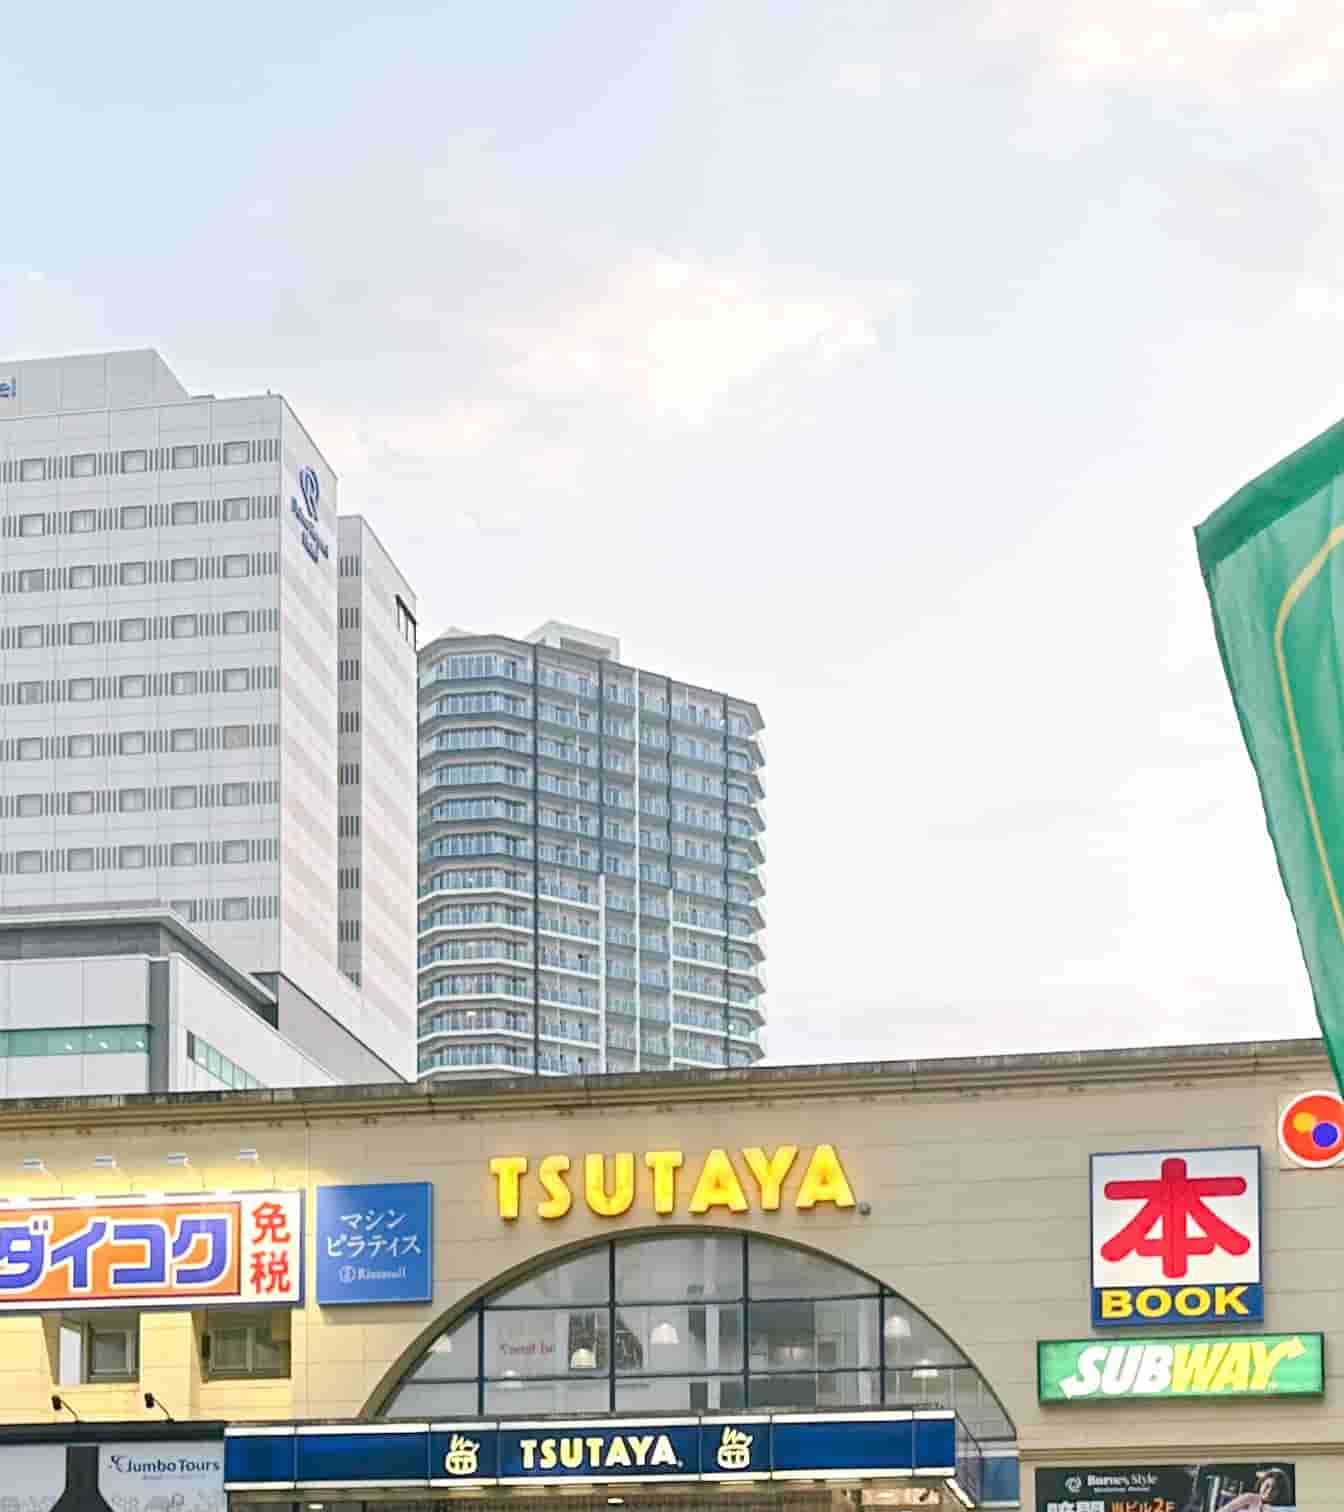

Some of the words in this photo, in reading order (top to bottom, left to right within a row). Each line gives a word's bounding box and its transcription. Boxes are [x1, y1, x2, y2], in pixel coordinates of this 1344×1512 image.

[489, 1143, 858, 1220] TSUTAYA
[340, 1209, 408, 1232] マシン
[1100, 1157, 1252, 1279] 本
[249, 1201, 293, 1296] 免税
[327, 1234, 422, 1259] ピラティス
[1100, 1285, 1250, 1320] BOOK
[1058, 1336, 1307, 1400] SUBWAY
[125, 1455, 177, 1474] Jumbo
[179, 1456, 221, 1473] Tours
[520, 1436, 678, 1469] TSUTAYA
